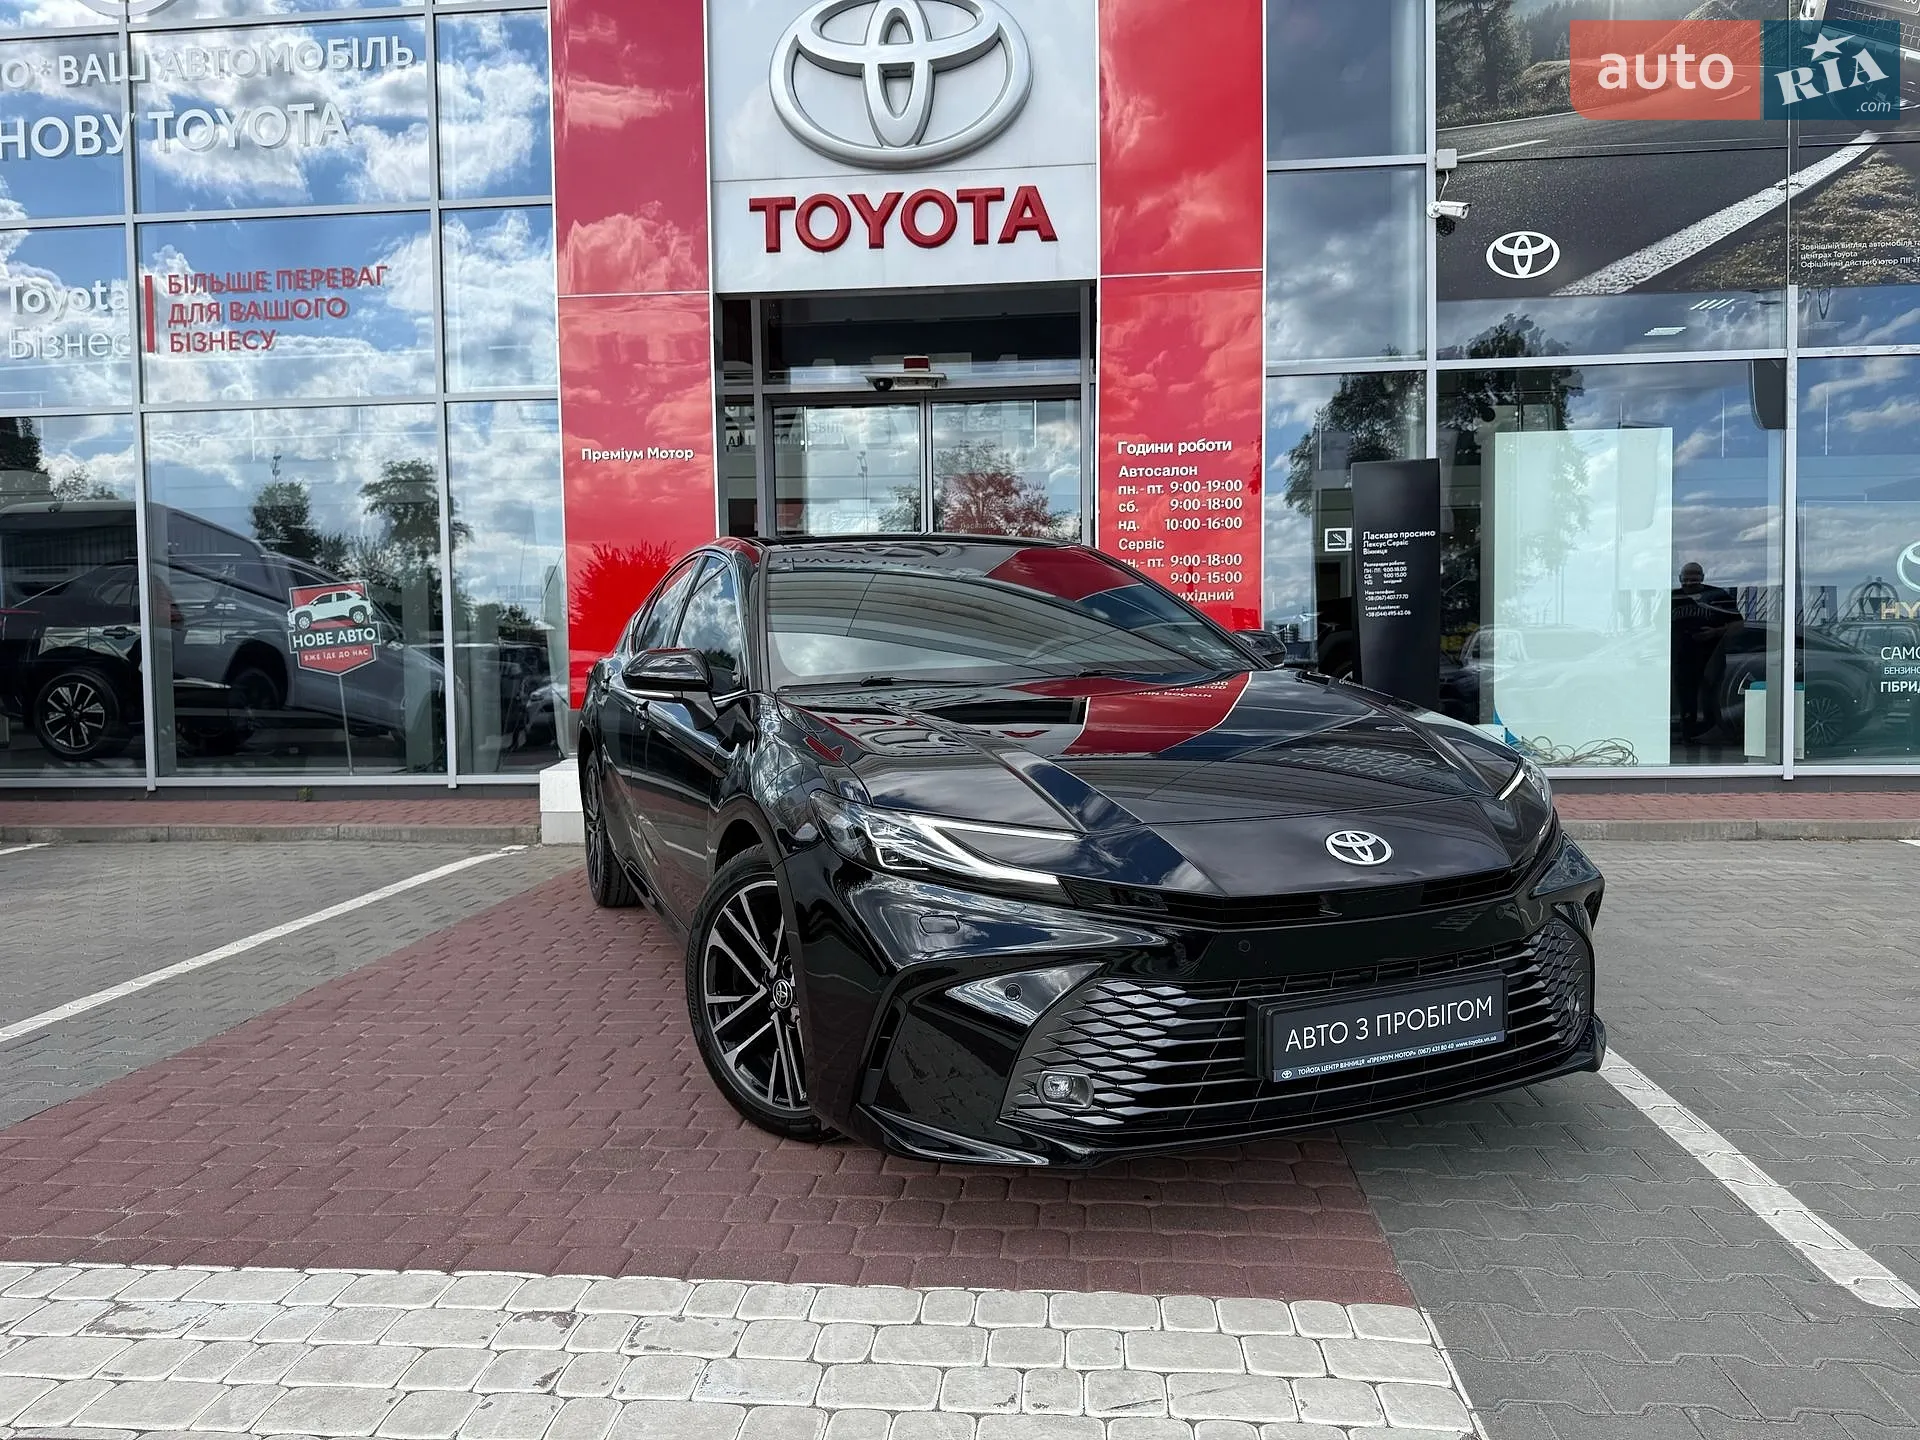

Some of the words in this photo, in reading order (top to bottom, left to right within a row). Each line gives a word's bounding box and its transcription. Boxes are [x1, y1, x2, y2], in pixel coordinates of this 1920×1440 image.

[58, 50, 146, 86] ВАШ
[160, 35, 414, 80] АВТОМОБІЛЬ
[147, 102, 350, 150] TOYOTA
[749, 185, 1058, 253] TOYOTA
[1834, 251, 1858, 259] Toyota
[168, 269, 267, 295] БІЛЬШЕ
[276, 265, 388, 291] ПЕРЕВАГ
[8, 278, 129, 321] Toyota
[168, 301, 221, 328] ДЛЯ
[229, 297, 348, 322] ВАШОГО
[9, 327, 131, 359] Бізнес
[170, 329, 277, 353] БІЗНЕСУ
[581, 447, 643, 462] Преміум
[647, 446, 694, 461] Мотор
[1117, 440, 1173, 456] Години
[1178, 438, 1232, 455] роботи
[1118, 465, 1198, 478] Автосалон
[1118, 500, 1139, 512] сб.
[1118, 520, 1140, 532] нд.
[1118, 537, 1165, 552] Сервіс
[1177, 588, 1235, 603] ихідний
[293, 630, 334, 649] НОВЕ
[337, 627, 376, 645] АВТО
[338, 649, 350, 659] ДО
[352, 648, 369, 657] НАС
[1880, 681, 1920, 693] ГІБРИ
[1286, 1021, 1348, 1053] АВТО
[1376, 995, 1493, 1037] ПРОБІГОМ
[1297, 1066, 1321, 1076] ТОЙОТА
[1321, 1063, 1339, 1073] ЦЕНТР
